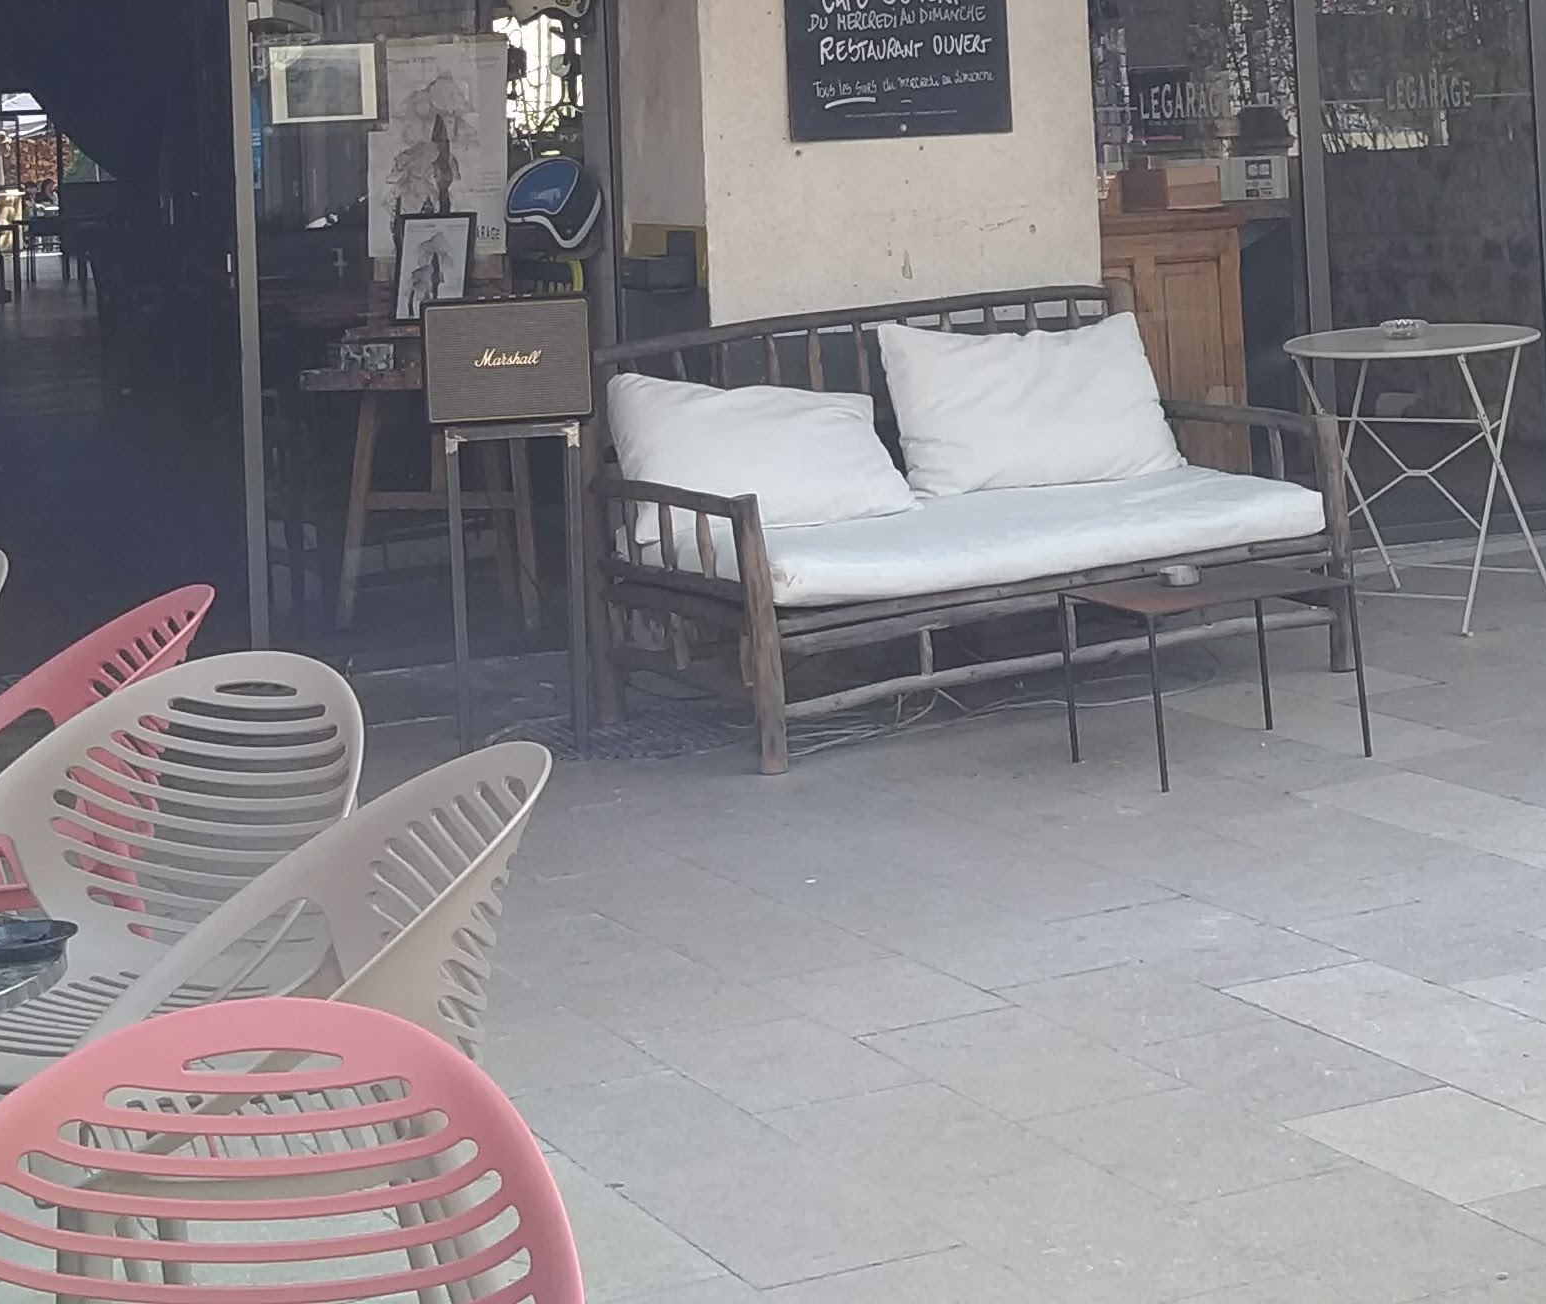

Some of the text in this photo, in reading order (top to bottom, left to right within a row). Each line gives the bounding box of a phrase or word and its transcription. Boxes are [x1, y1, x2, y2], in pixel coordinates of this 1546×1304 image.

[807, 13, 829, 32] DU
[900, 8, 916, 27] AU
[820, 34, 993, 66] RESTAURANT OUVERT
[839, 78, 852, 96] les
[474, 348, 542, 368] Marshall
